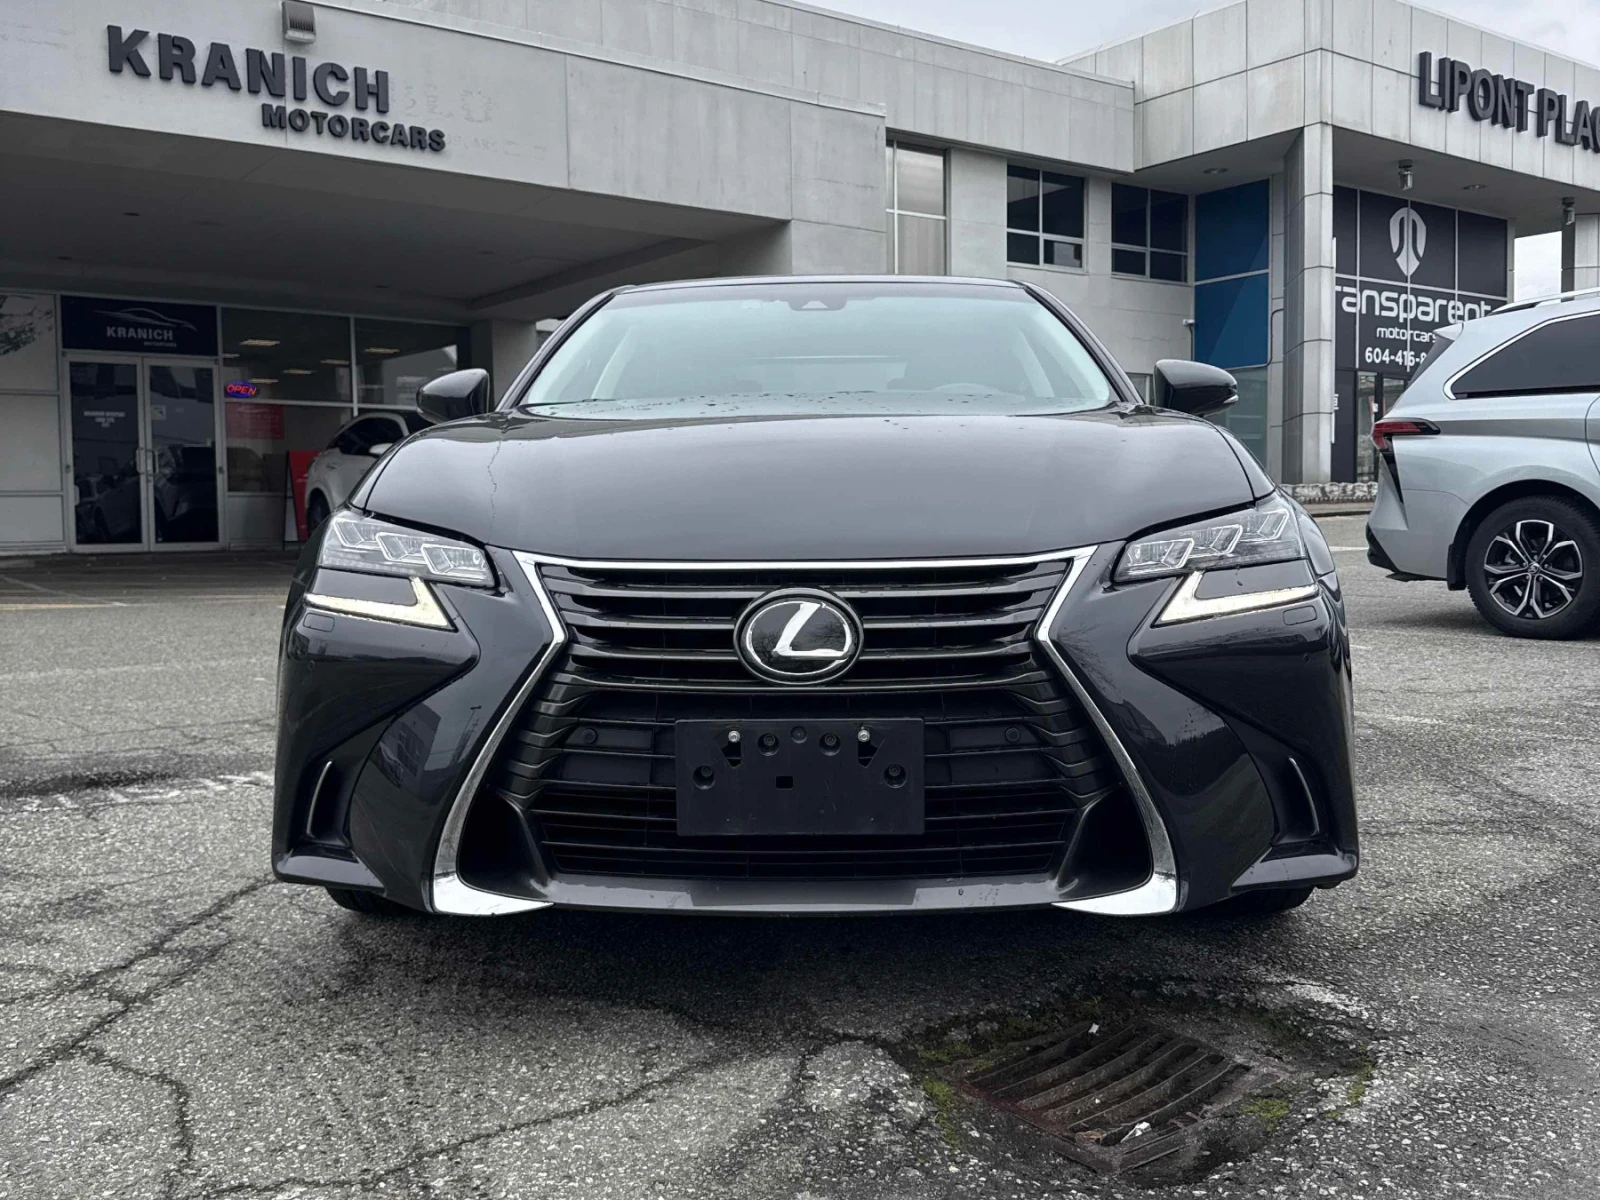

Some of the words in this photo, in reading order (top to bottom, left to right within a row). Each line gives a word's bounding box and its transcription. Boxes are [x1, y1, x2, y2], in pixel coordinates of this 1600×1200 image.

[107, 25, 389, 113] KRANICH
[1419, 51, 1535, 132] LIPONT
[262, 103, 446, 151] MOTORCARS
[106, 326, 174, 340] KRANICH
[226, 383, 257, 395] OPEN
